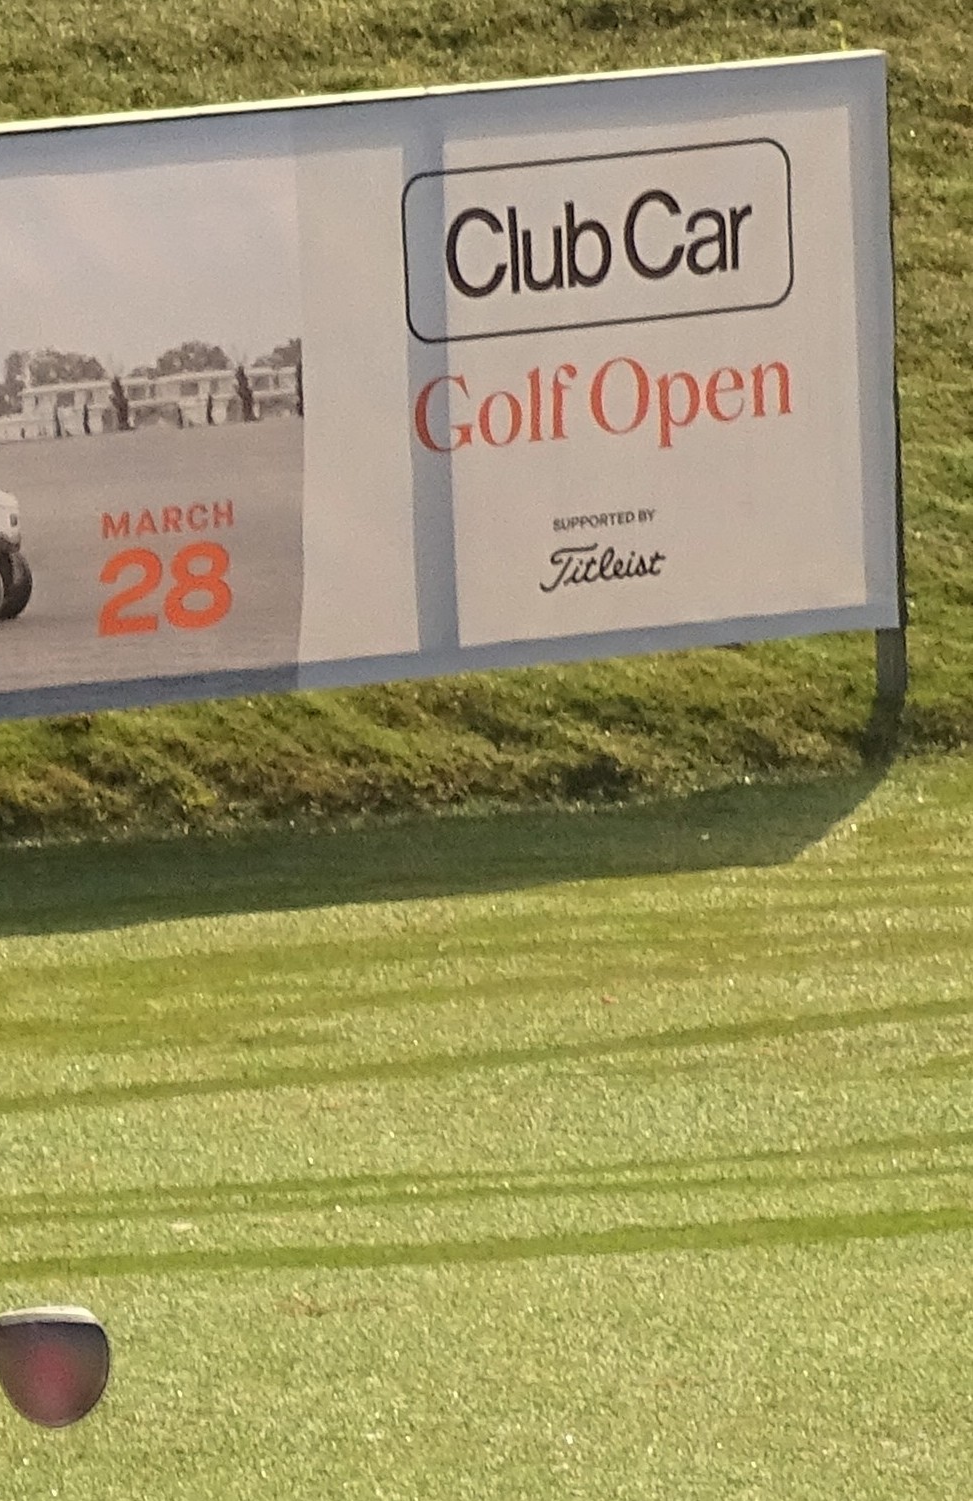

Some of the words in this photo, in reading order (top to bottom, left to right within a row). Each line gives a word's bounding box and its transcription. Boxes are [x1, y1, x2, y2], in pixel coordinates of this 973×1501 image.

[445, 201, 612, 298] Club
[624, 189, 753, 280] Car
[414, 363, 578, 454] Golf
[589, 356, 793, 449] Open
[100, 499, 235, 540] MARCH
[552, 510, 635, 532] SUPPORTED
[638, 508, 656, 523] BY
[98, 539, 233, 637] 28
[539, 542, 666, 592] Titleist
